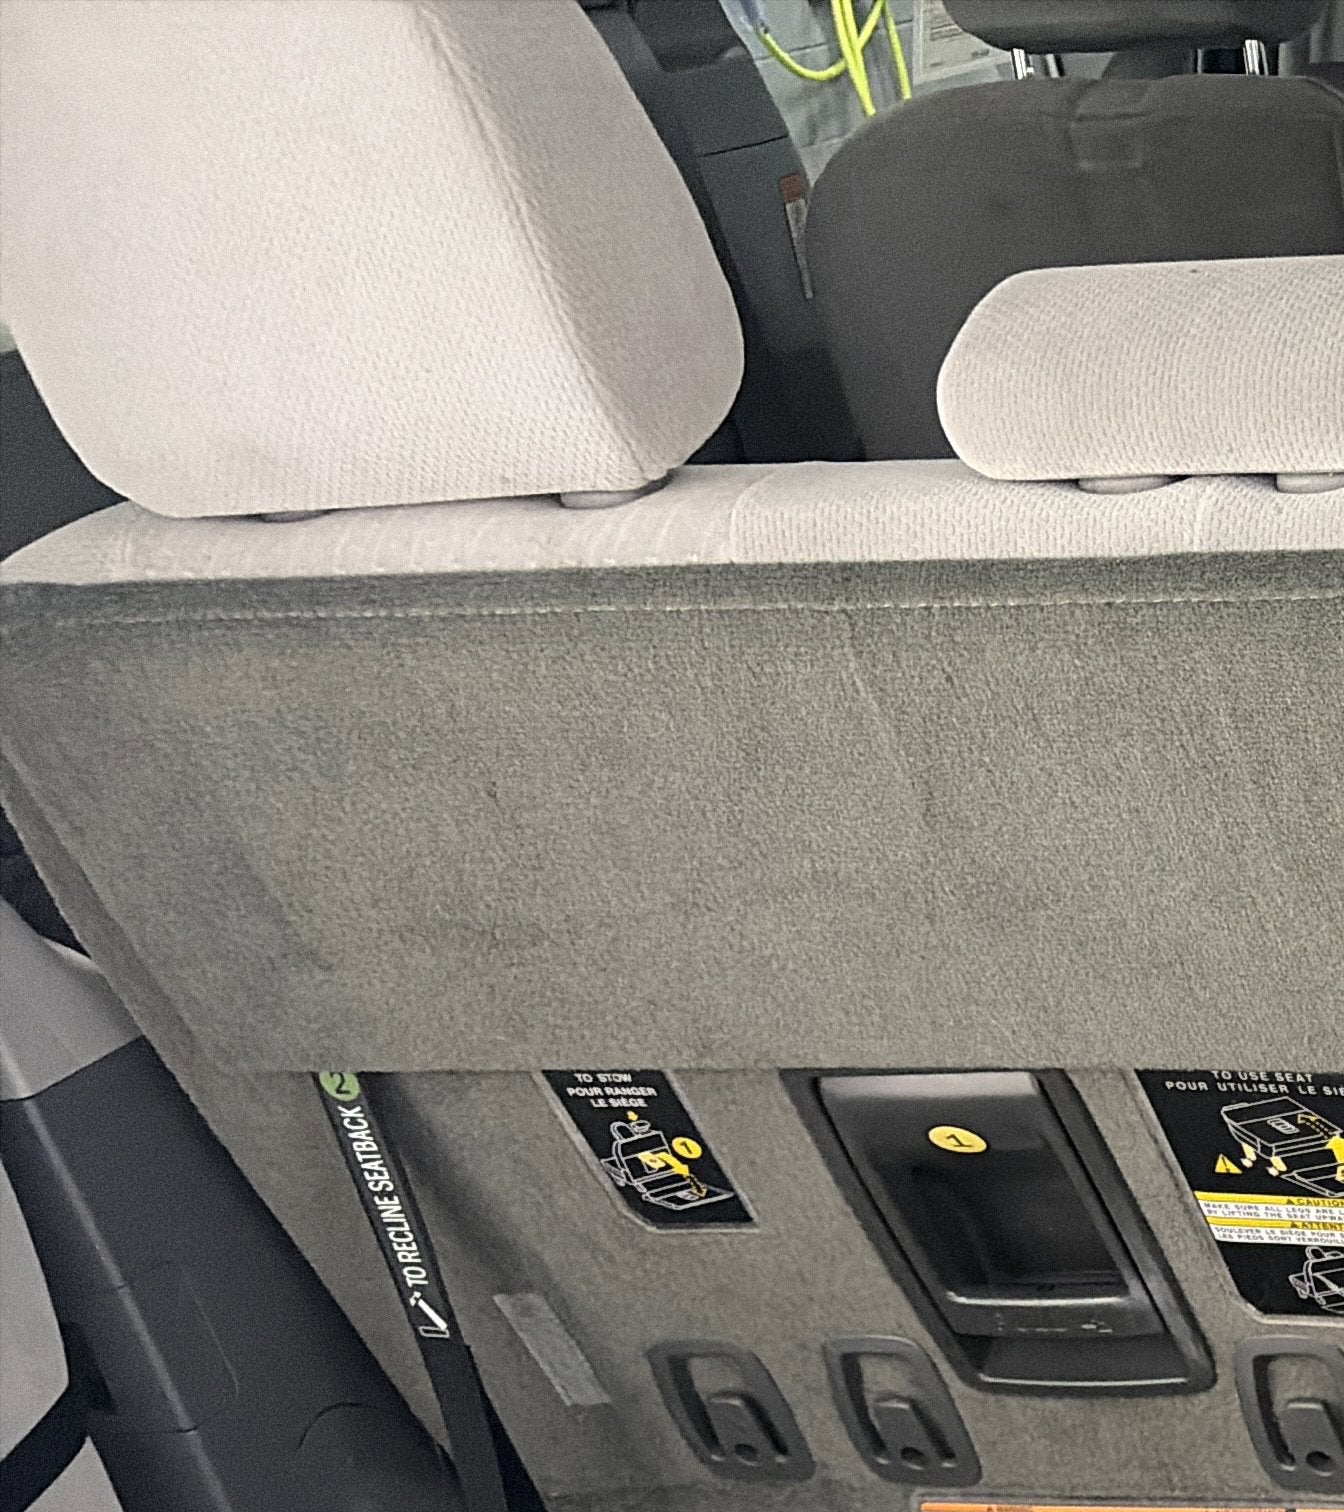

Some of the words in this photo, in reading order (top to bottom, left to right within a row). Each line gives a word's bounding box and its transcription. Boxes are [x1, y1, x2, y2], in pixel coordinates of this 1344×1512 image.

[329, 1072, 351, 1095] 2
[573, 1072, 593, 1083] TO
[596, 1072, 633, 1083] STOW
[1211, 1070, 1232, 1080] TO
[1238, 1071, 1270, 1082] USE
[1274, 1072, 1313, 1084] SEAT
[566, 1086, 604, 1097] POUR
[604, 1086, 658, 1097] RANGER
[1164, 1080, 1209, 1091] POUR
[1216, 1082, 1290, 1094] UTILISER
[1298, 1085, 1317, 1095] LE
[589, 1098, 609, 1108] LE
[337, 1105, 395, 1192] SEATBACK
[679, 1140, 693, 1156] 1
[946, 1134, 973, 1148] 1
[374, 1195, 422, 1263] RECLINE
[403, 1265, 429, 1288] TO
